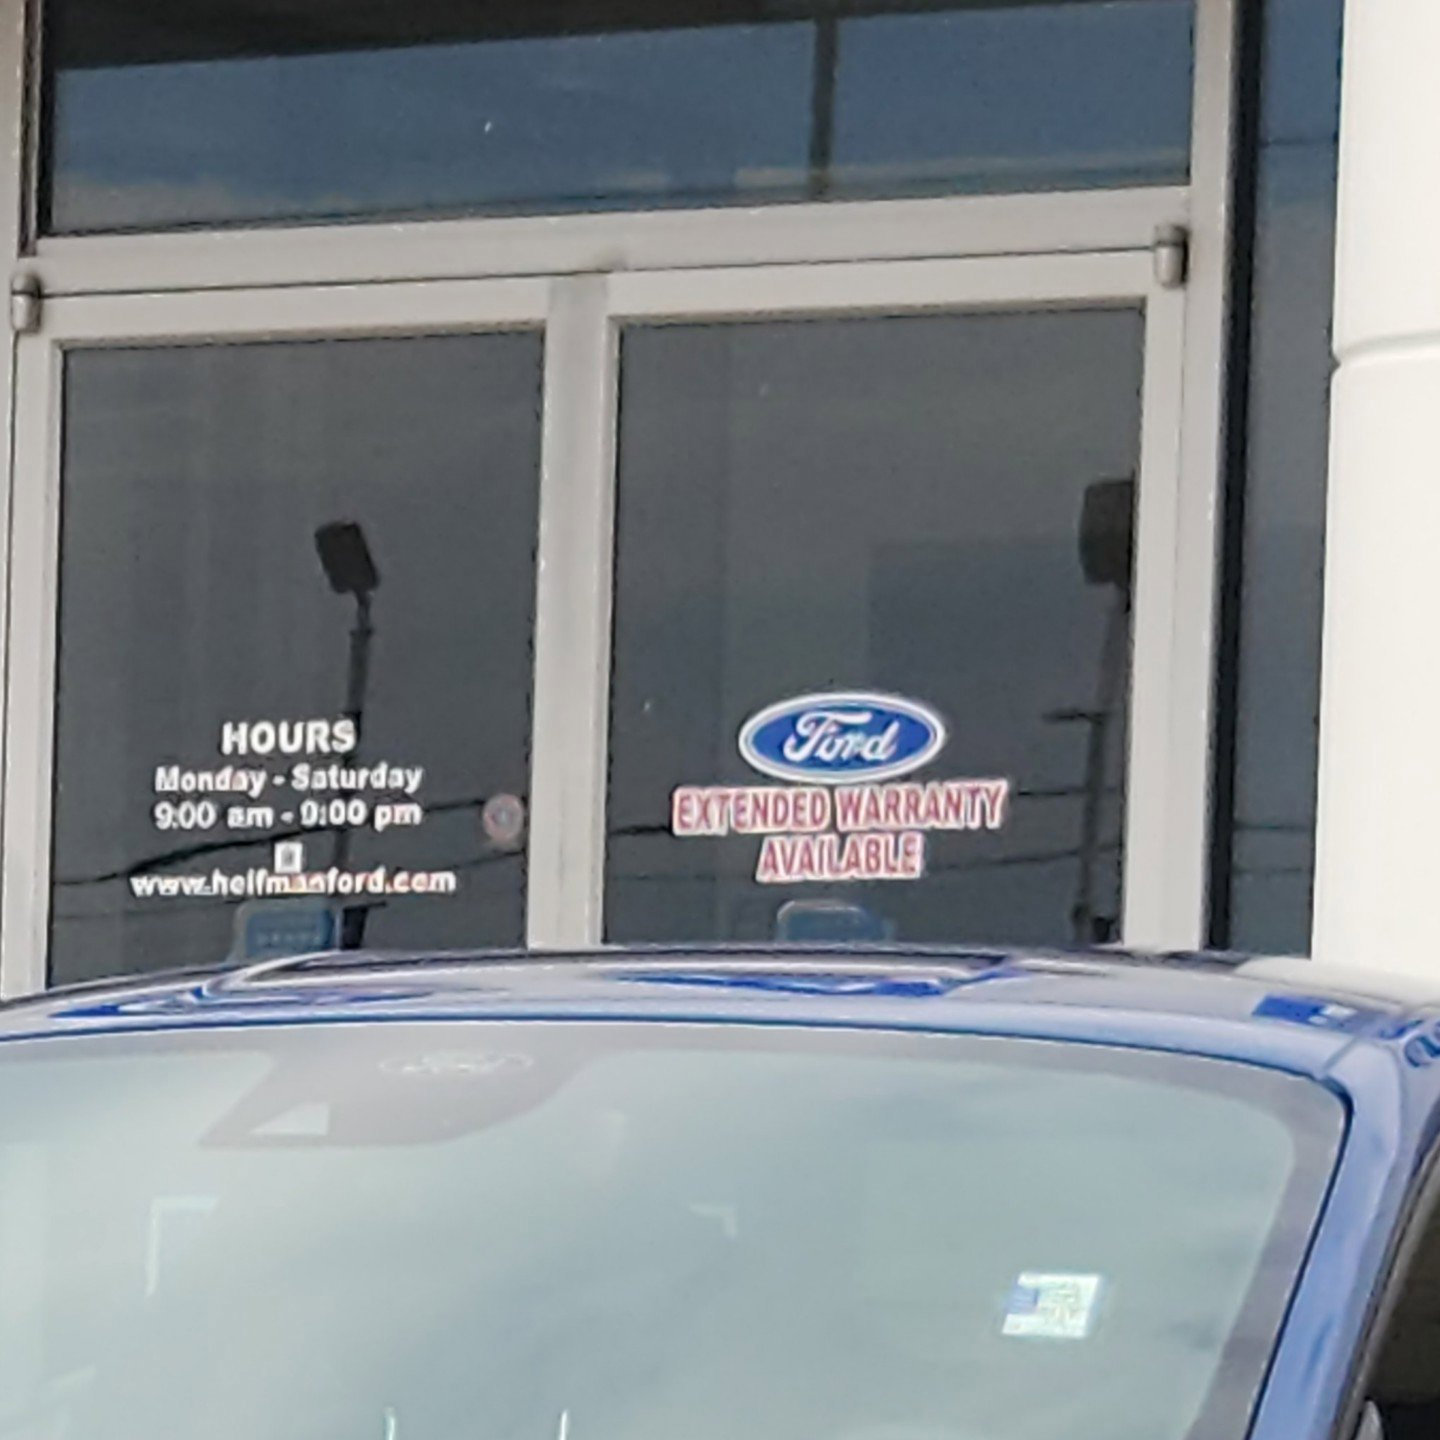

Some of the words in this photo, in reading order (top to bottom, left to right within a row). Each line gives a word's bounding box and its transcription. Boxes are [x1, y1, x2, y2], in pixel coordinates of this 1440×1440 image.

[221, 718, 357, 755] HOURS
[783, 709, 901, 763] Ford
[154, 764, 268, 799] Monday
[290, 759, 424, 795] Saturday
[153, 799, 218, 831] 9:00
[227, 804, 275, 829] am
[374, 802, 422, 832] pm
[674, 786, 829, 834] EXTENDED
[835, 780, 1007, 831] WARRANTY
[757, 833, 923, 881] AVAILABLE
